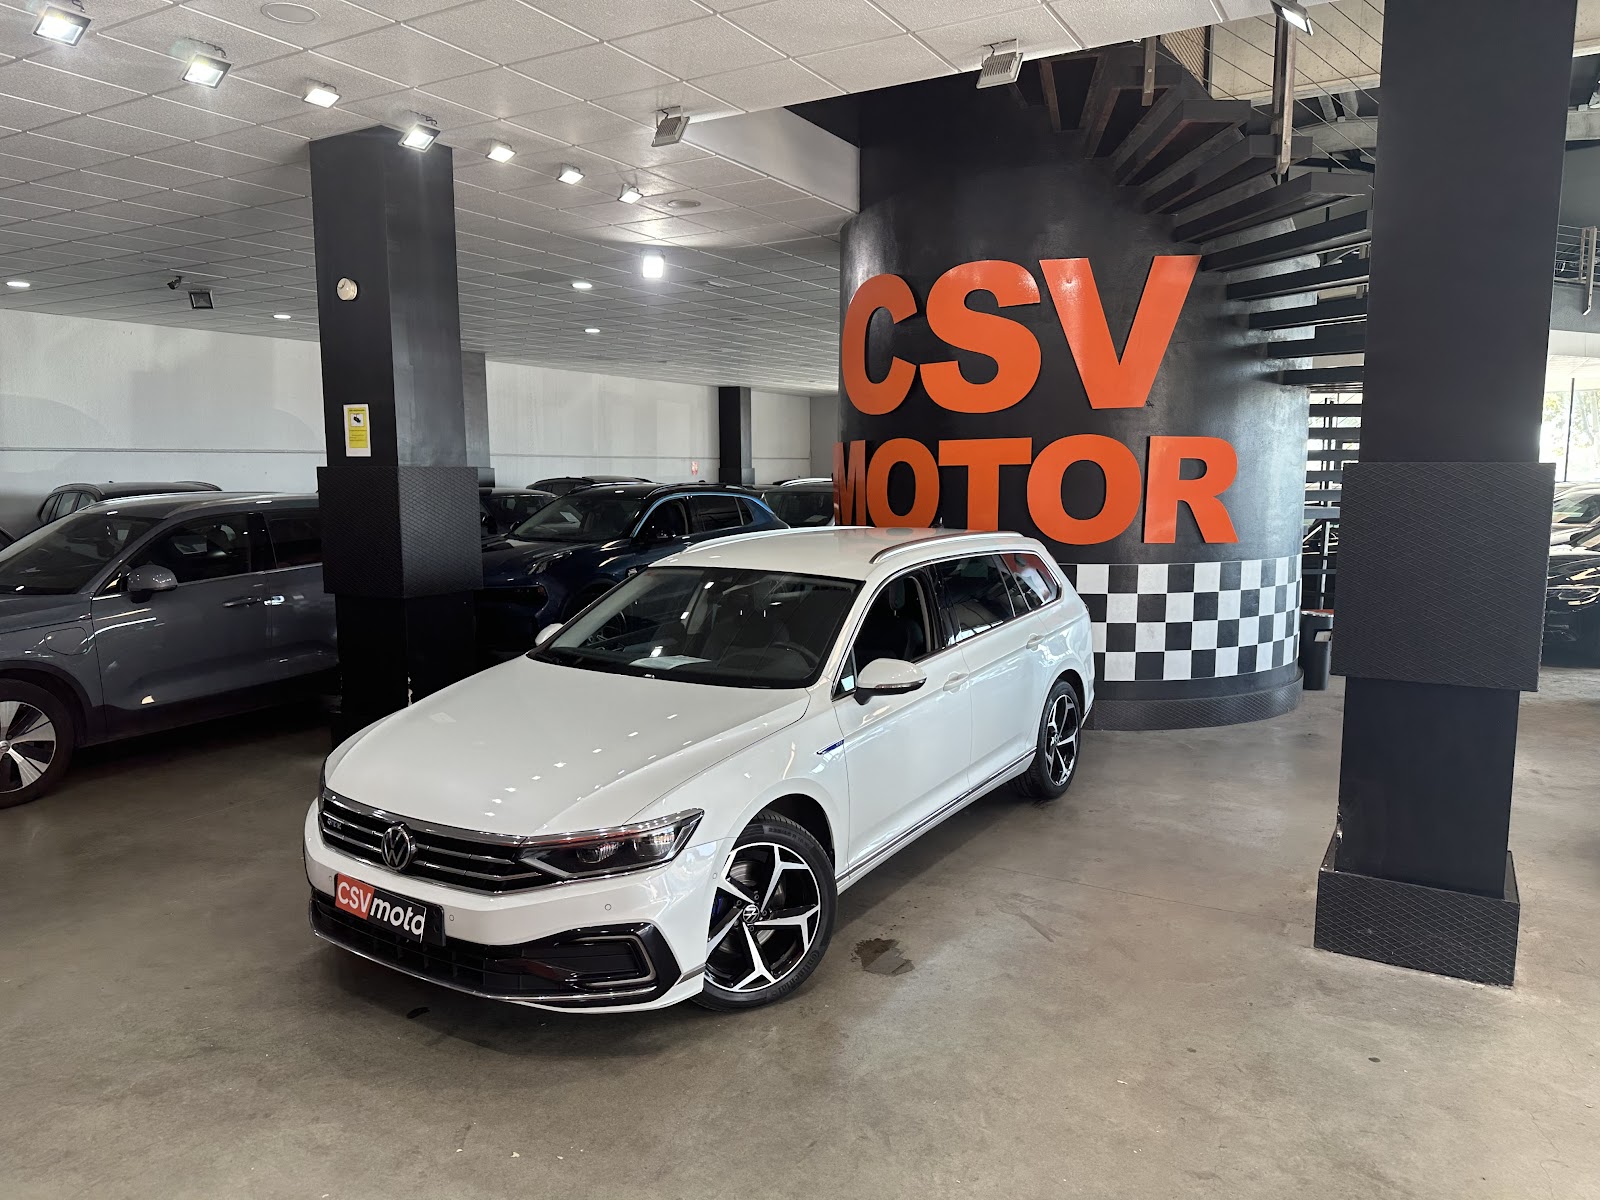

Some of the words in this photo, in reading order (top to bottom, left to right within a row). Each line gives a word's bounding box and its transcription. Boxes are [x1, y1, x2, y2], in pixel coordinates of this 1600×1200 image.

[841, 254, 1203, 416] CSV
[833, 433, 1239, 546] MOTOR
[777, 949, 820, 994] Continental
